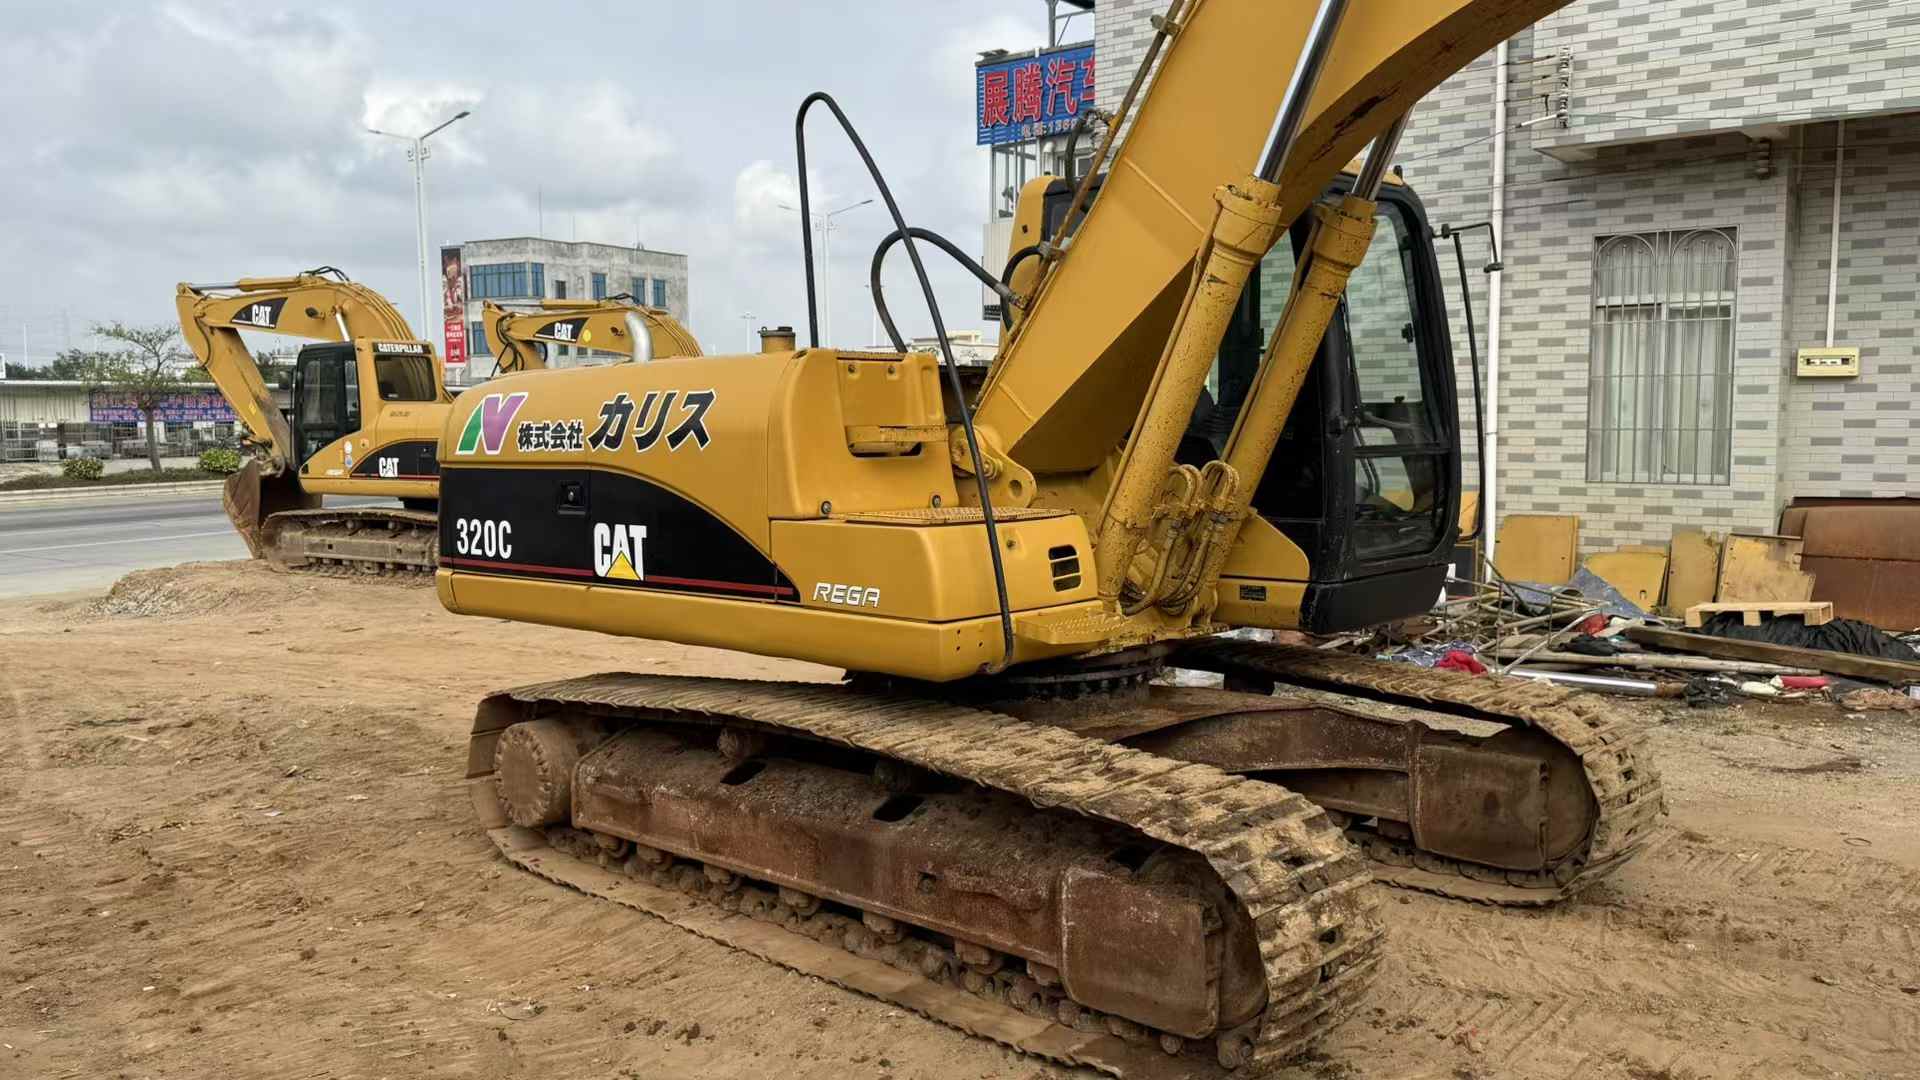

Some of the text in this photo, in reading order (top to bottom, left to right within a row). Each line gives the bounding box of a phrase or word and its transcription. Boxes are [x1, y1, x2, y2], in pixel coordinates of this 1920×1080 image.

[251, 304, 272, 326] CAT
[554, 322, 574, 339] CAT
[378, 343, 423, 353] CATERPILLAR
[517, 389, 718, 454] 株式会社 カリス
[378, 457, 400, 478] CAT
[456, 518, 513, 560] 320C
[593, 522, 648, 581] CAT
[812, 582, 881, 608] REGA
